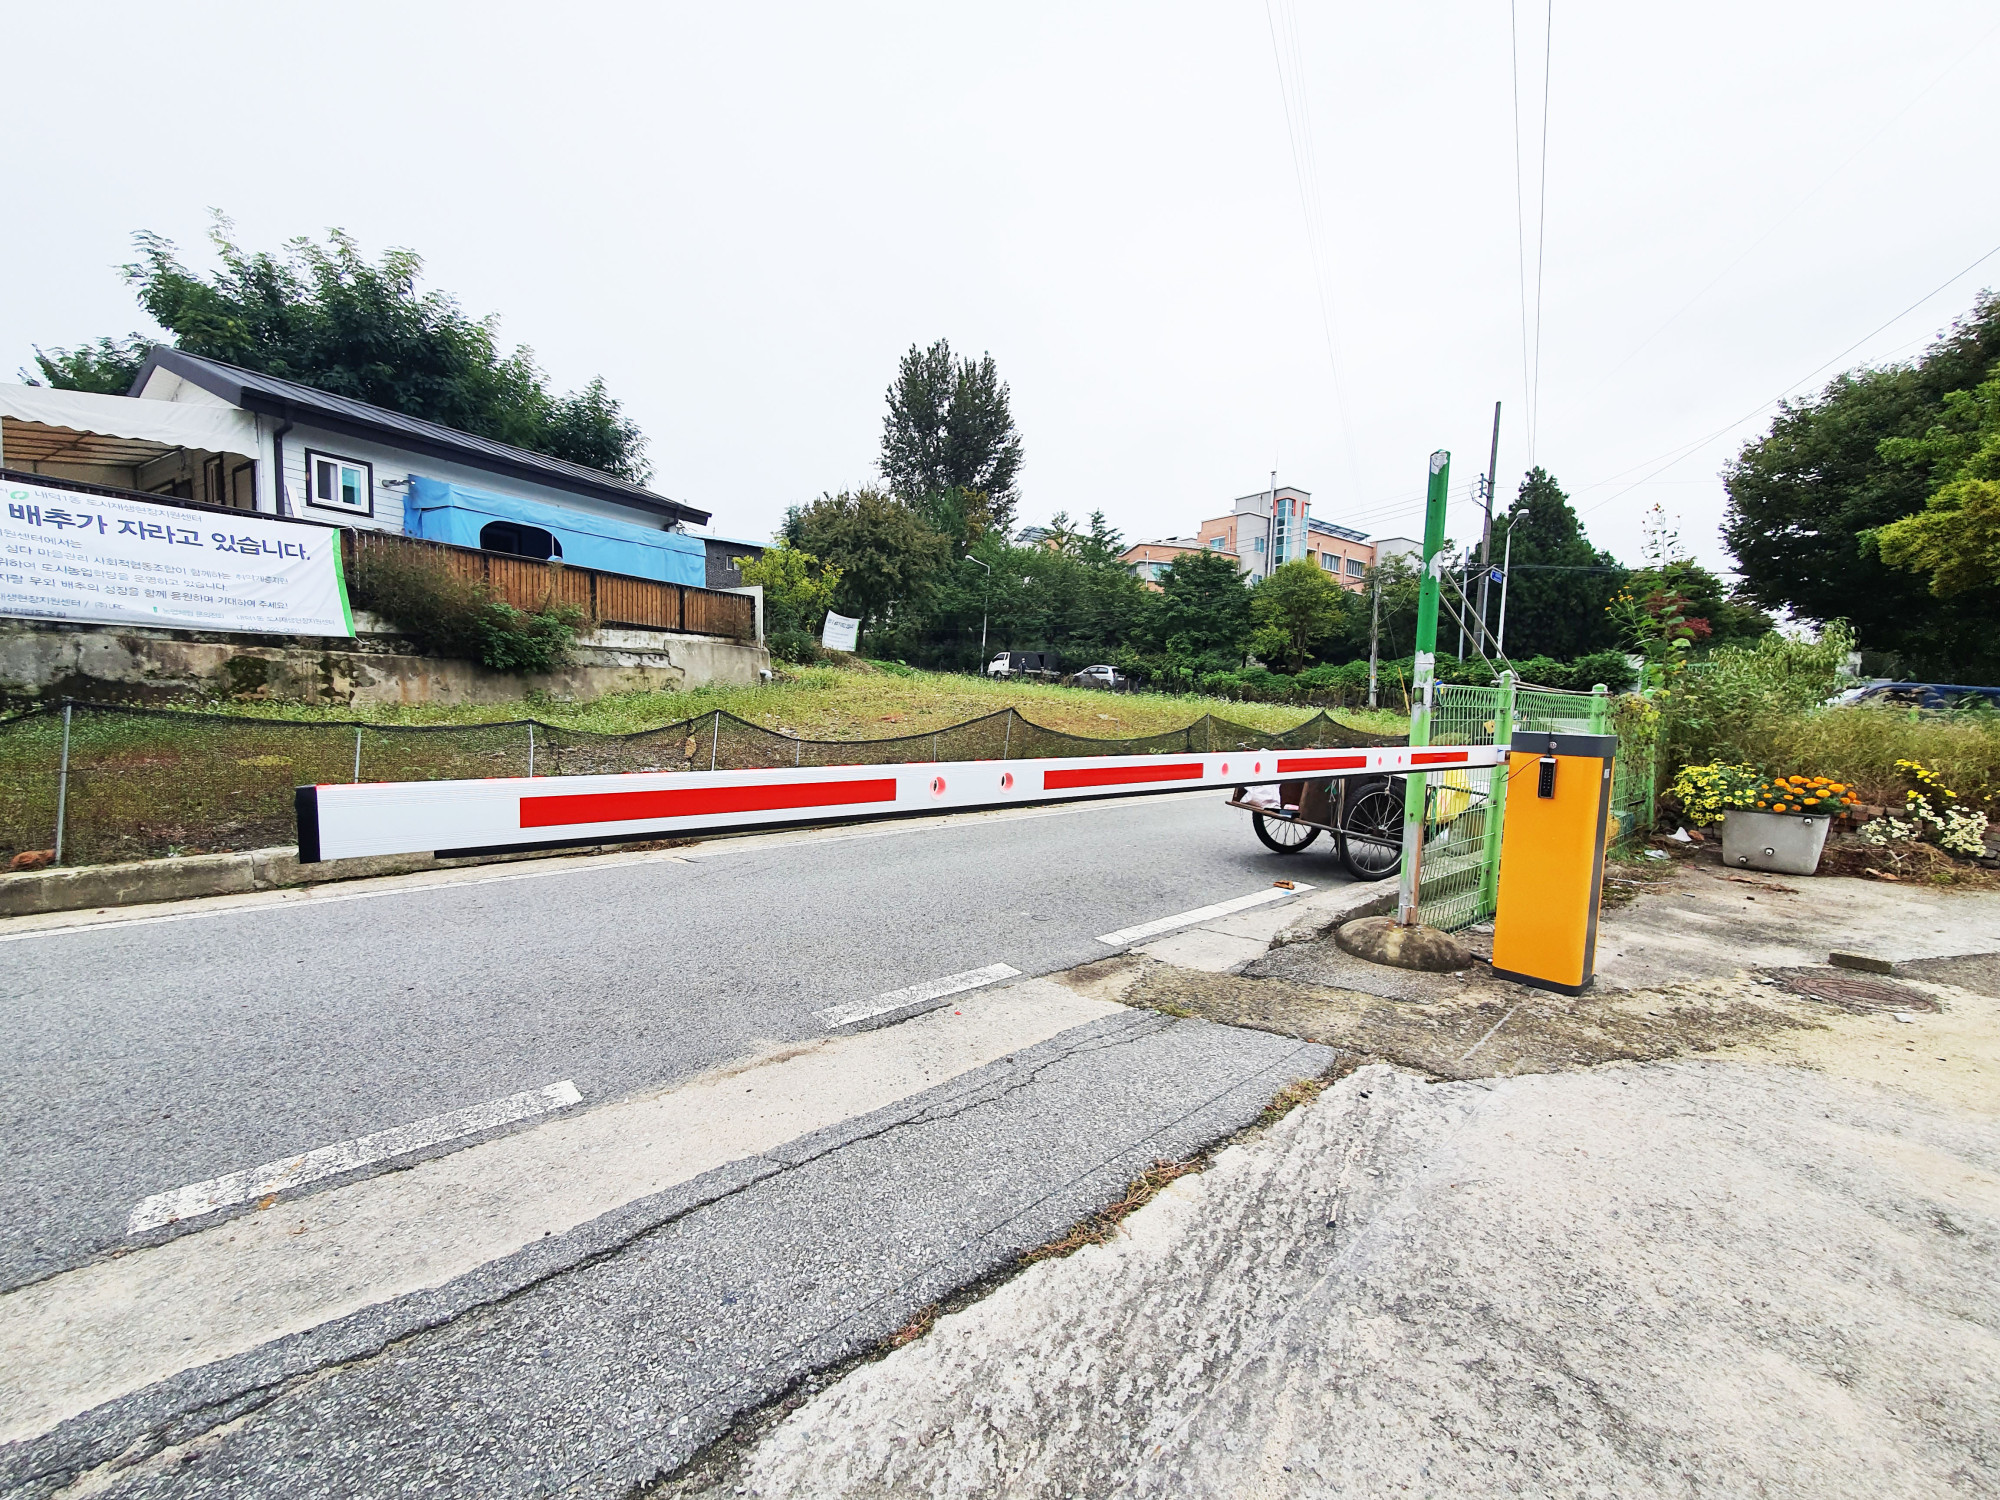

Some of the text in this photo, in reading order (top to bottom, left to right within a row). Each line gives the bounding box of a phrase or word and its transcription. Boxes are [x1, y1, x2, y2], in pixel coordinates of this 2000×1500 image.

[0, 528, 82, 548] 원센터에서는
[8, 503, 311, 560] 배추가 자라고 있습니다.
[94, 556, 187, 574] 사회적협동조합이
[61, 580, 99, 592] 배추의
[104, 585, 139, 597] 성장을
[144, 588, 168, 599] 함께
[170, 591, 214, 603] 응원하며
[217, 596, 256, 607] 기대하여
